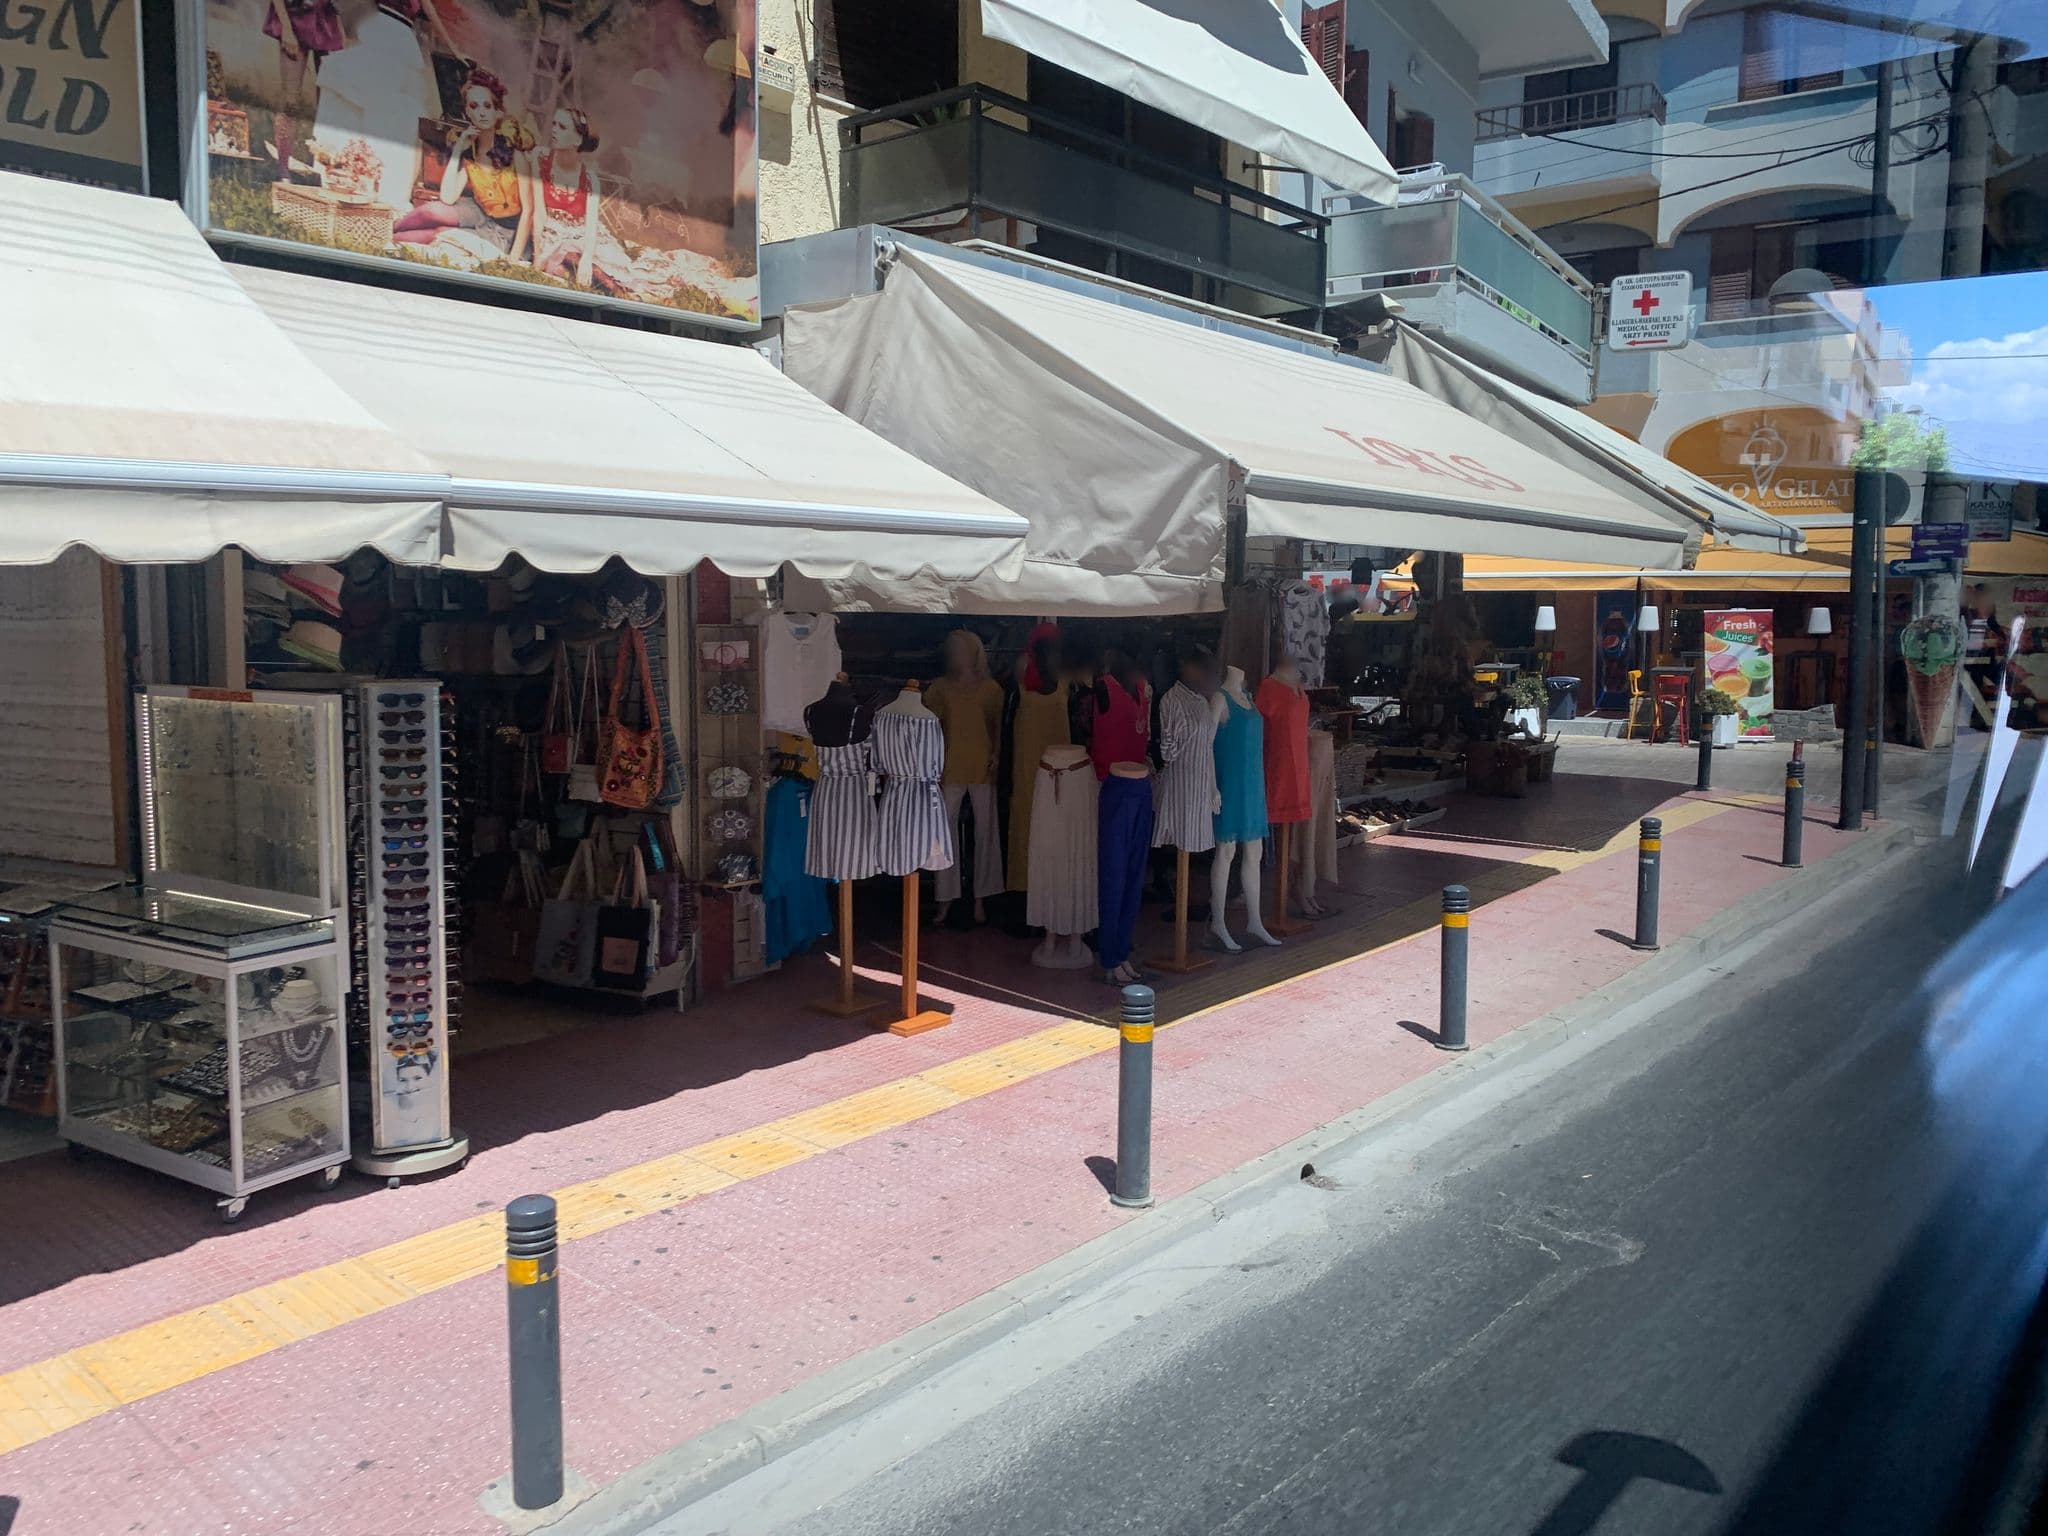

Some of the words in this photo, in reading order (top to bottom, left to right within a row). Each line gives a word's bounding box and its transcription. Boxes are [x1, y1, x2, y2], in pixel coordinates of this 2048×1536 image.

[0, 64, 110, 135] LD
[1617, 324, 1650, 332] MEDICAL
[1651, 322, 1677, 330] OFFICE
[1643, 330, 1671, 338] PRAXIS
[1723, 619, 1757, 630] Fresh
[1721, 630, 1754, 643] Juices
